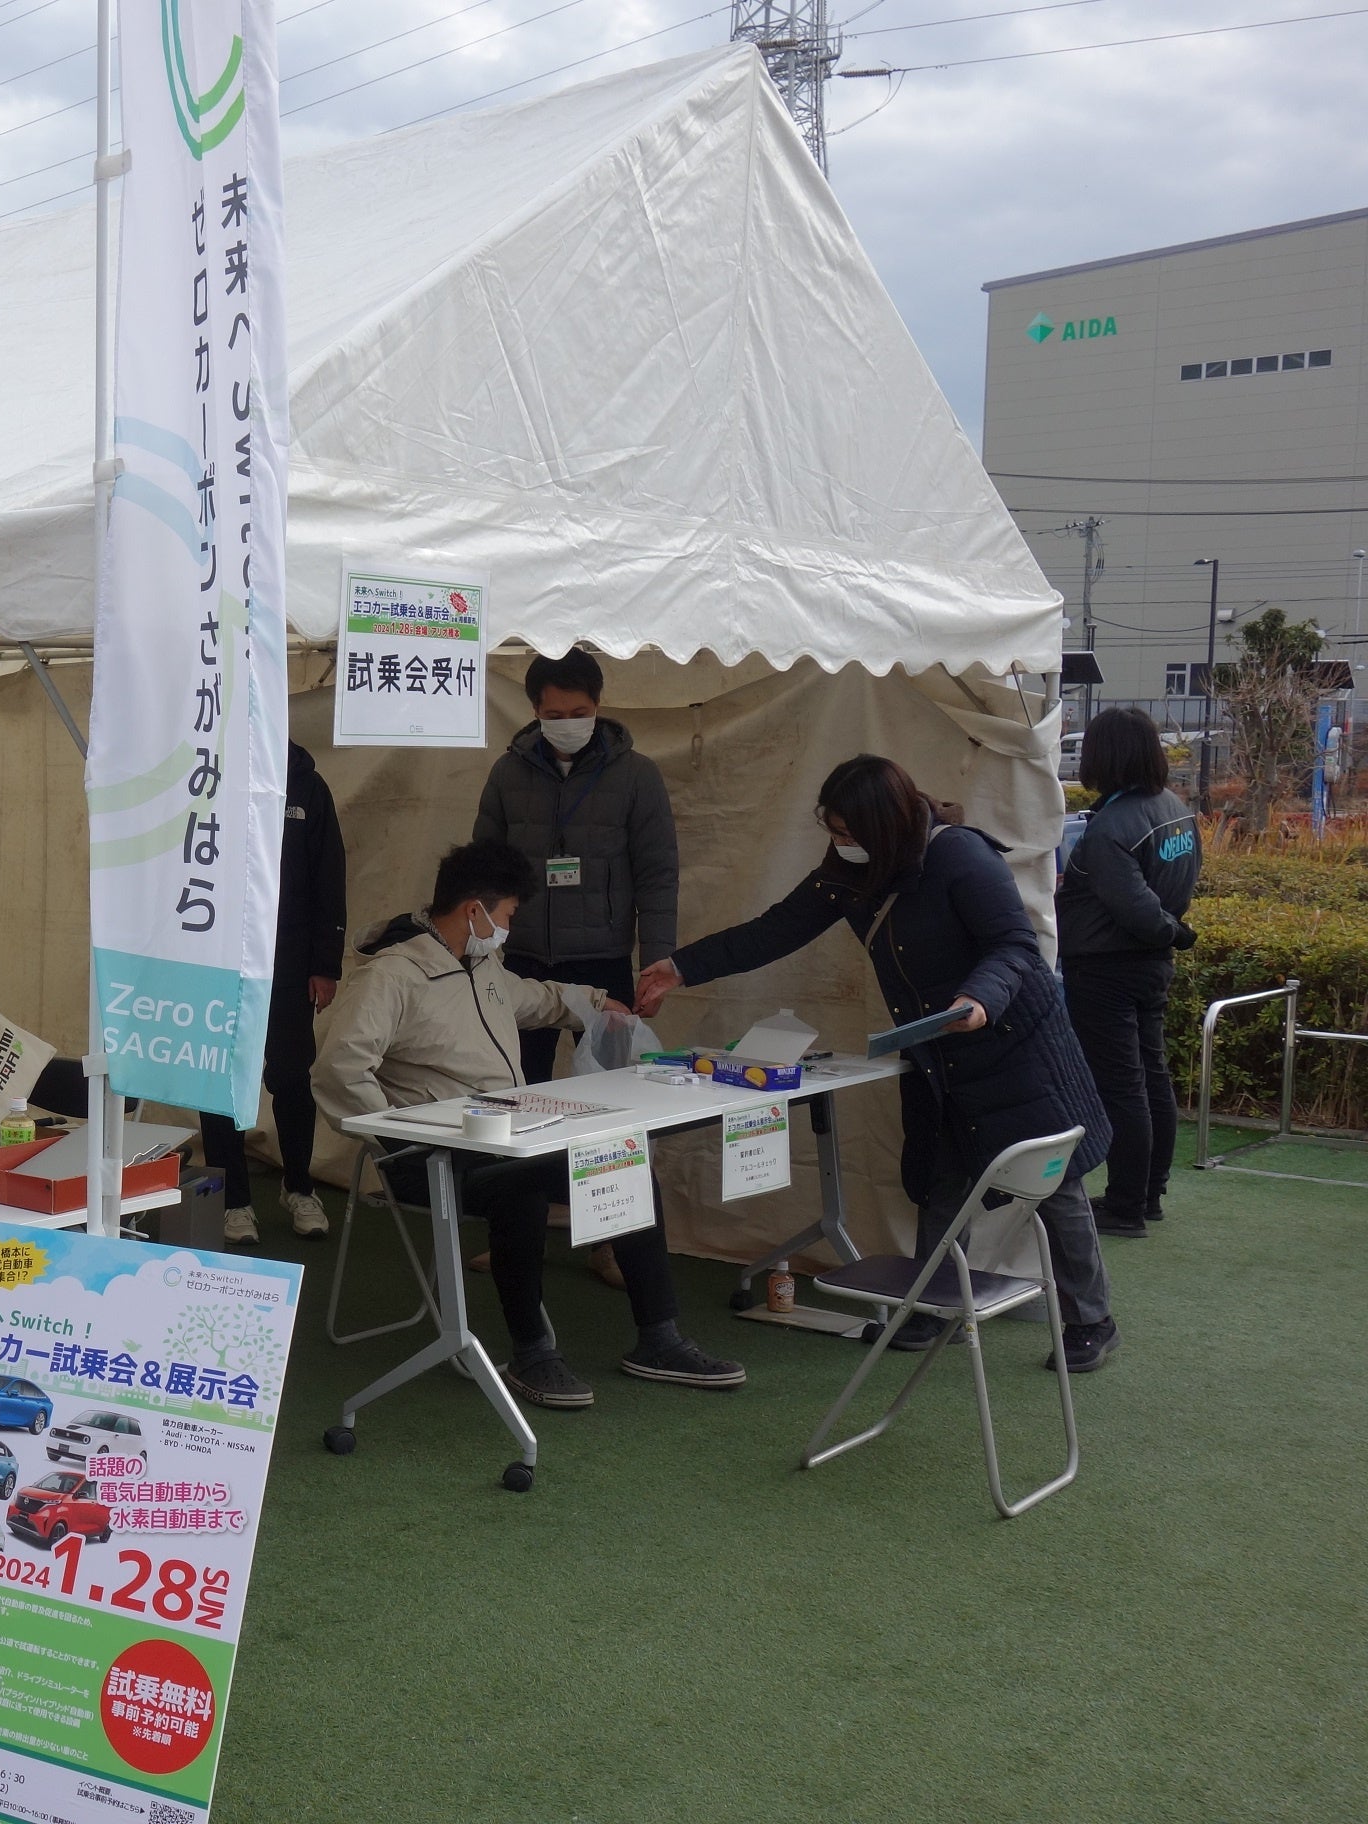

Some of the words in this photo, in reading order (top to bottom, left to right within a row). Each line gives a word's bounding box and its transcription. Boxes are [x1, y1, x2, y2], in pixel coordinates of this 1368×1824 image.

[1062, 316, 1118, 341] AIDA
[354, 586, 374, 596] 未来へ
[375, 587, 397, 598] Switch
[353, 600, 450, 621] エコカー試乗会&展示会
[373, 624, 389, 633] 2024
[391, 622, 409, 635] 1.28
[347, 652, 476, 697] 試乗会受付
[105, 982, 195, 1029] Zero
[186, 1280, 280, 1303] ゼロカーボンさがみはら
[10, 1310, 75, 1337] Switch
[162, 1418, 224, 1437] 協力自動車メーカー
[89, 1457, 143, 1479] 話題の
[100, 1480, 228, 1504] 電気自動車から
[113, 1507, 245, 1531] 水素自動車まで
[52, 1533, 197, 1624] 1.28
[195, 1568, 230, 1631] SUN
[108, 1667, 212, 1719] 試乗無料
[111, 1700, 200, 1741] 事前予約可能
[131, 1726, 173, 1747] ※先着順
